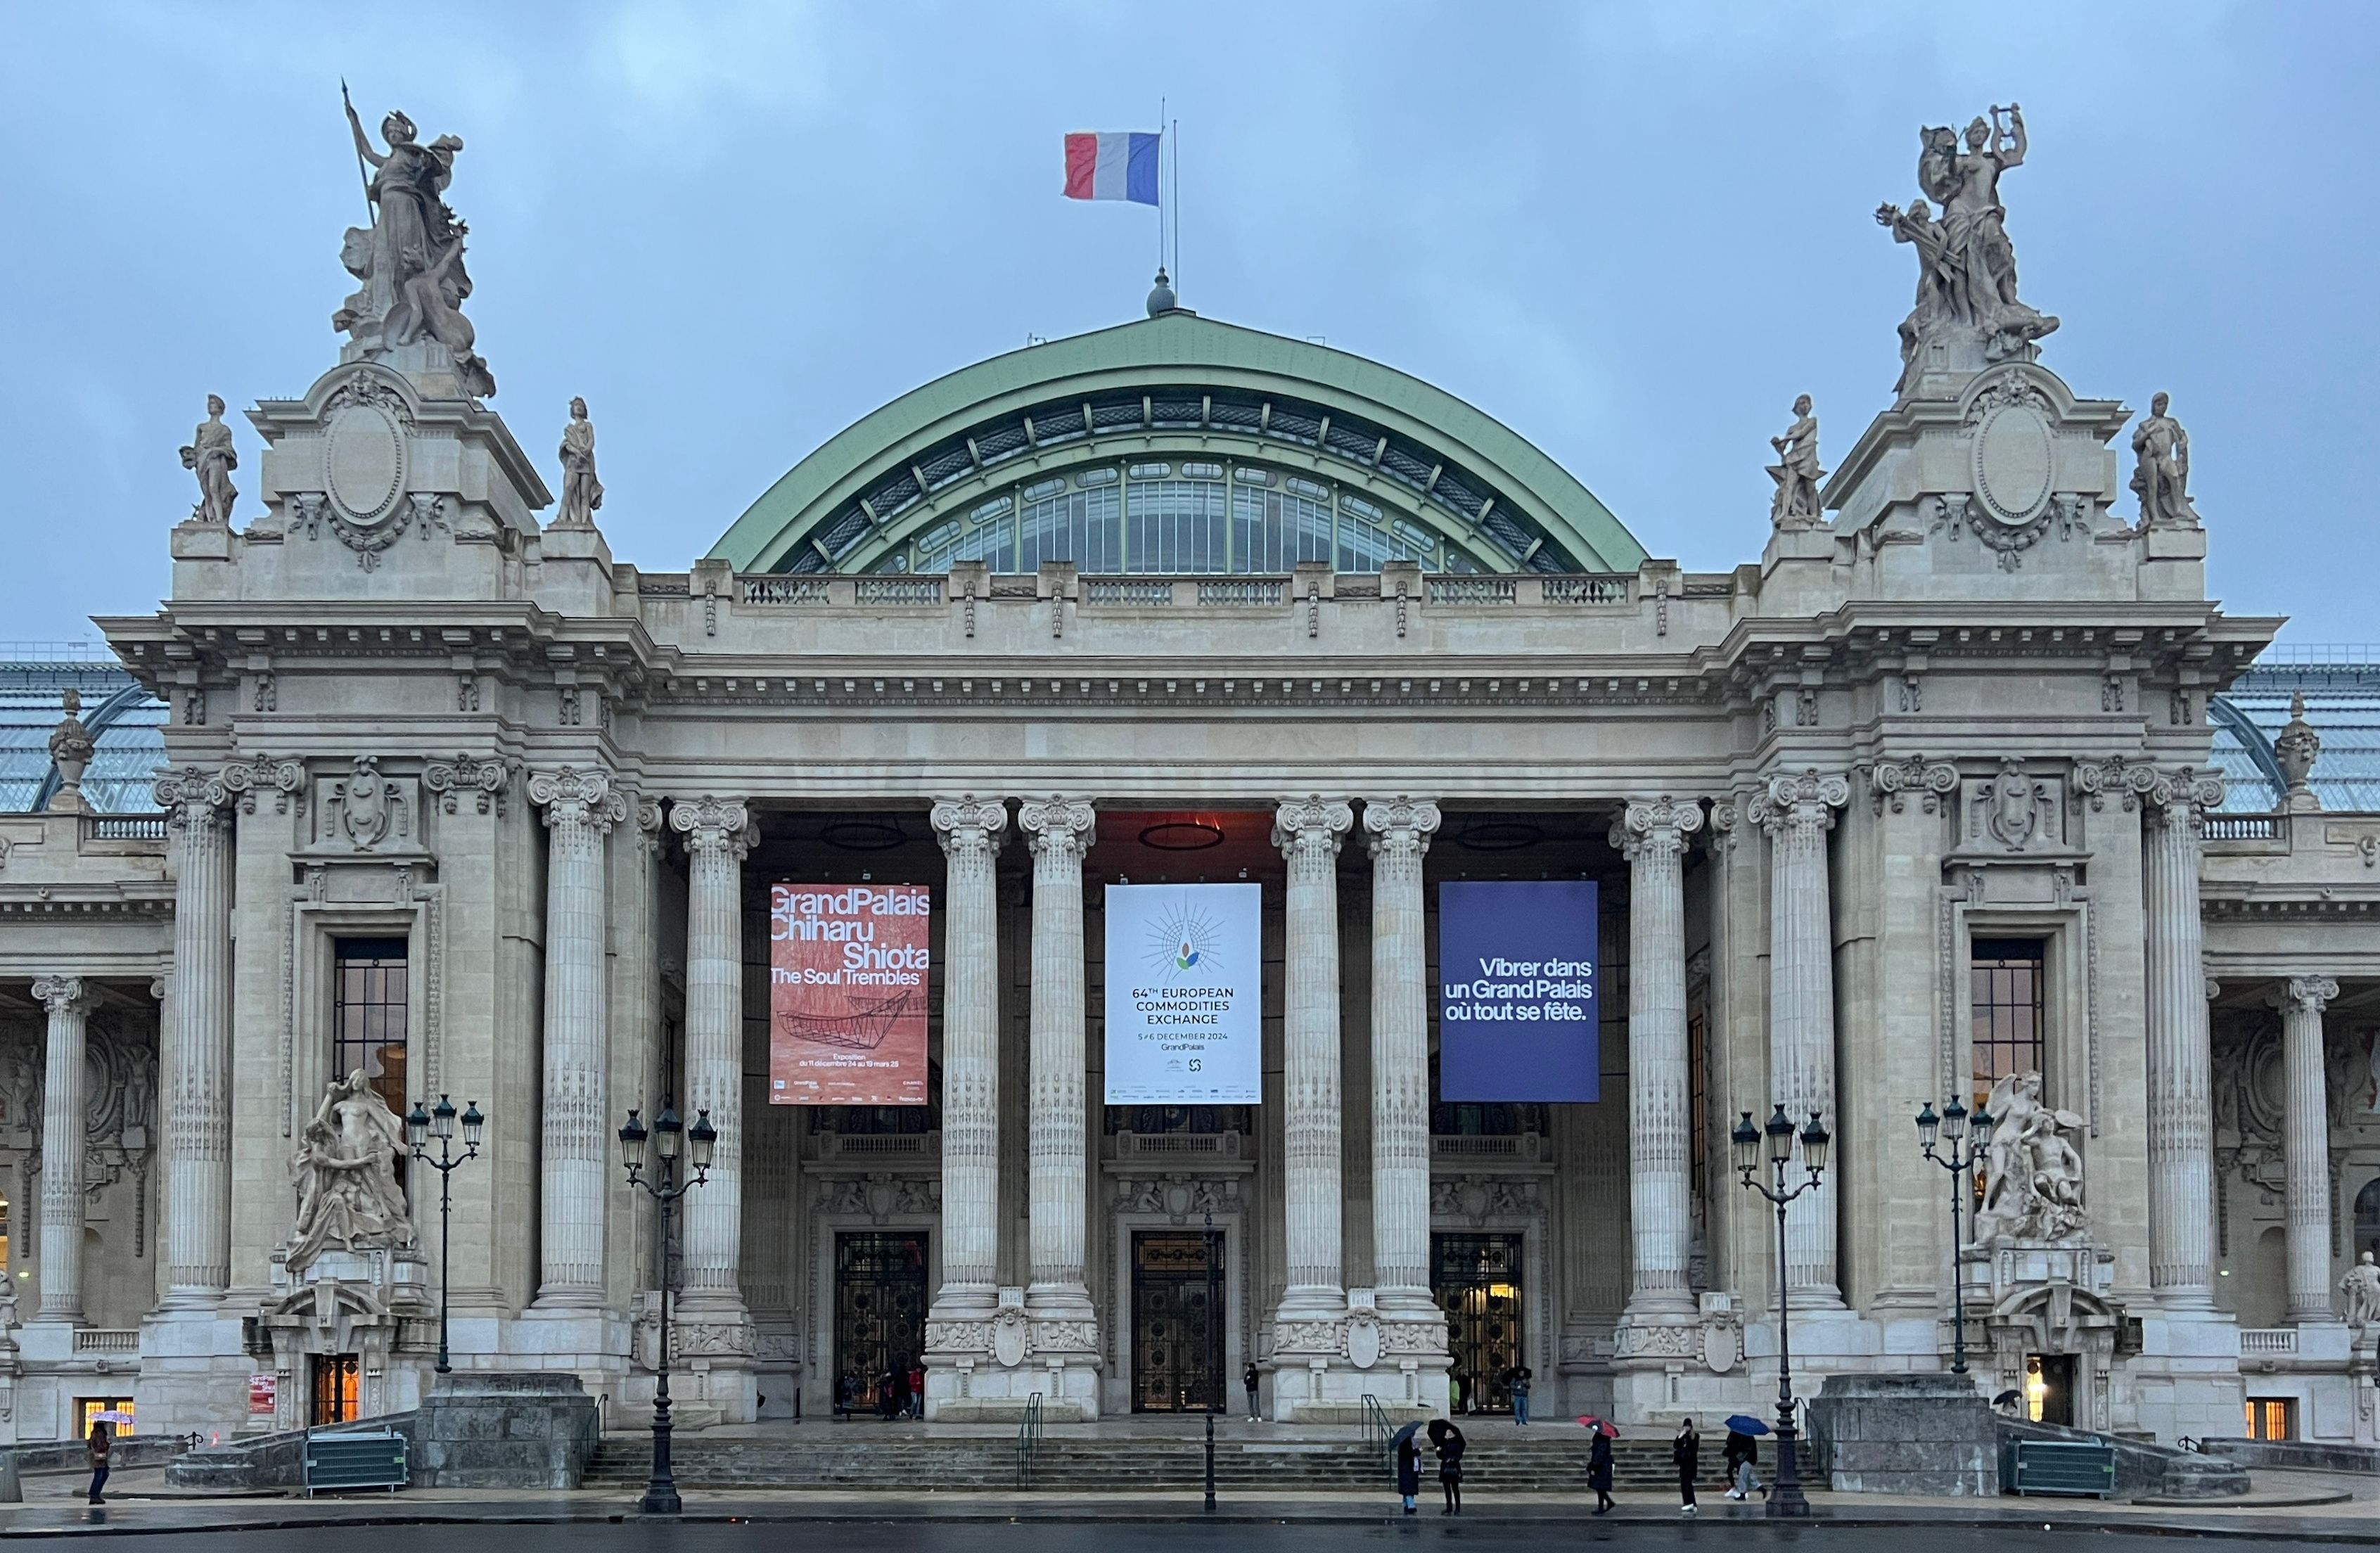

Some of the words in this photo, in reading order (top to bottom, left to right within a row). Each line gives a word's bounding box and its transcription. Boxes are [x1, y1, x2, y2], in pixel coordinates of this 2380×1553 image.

[771, 886, 929, 915] GrandPalais
[771, 914, 874, 942] Chiharu
[844, 942, 929, 969] Shiota
[772, 968, 802, 984] The
[804, 968, 840, 985] Soul
[843, 969, 920, 985] Trembles
[1479, 958, 1541, 977] Vibrer
[1544, 958, 1592, 977] dans
[1162, 988, 1234, 998] EUROPEAN
[1445, 984, 1470, 999] un
[1472, 980, 1534, 999] Grand
[1536, 980, 1593, 999] Palais
[1137, 1001, 1229, 1011] COMMODITIES
[1445, 1002, 1471, 1021] où
[1473, 1002, 1514, 1021] tout
[1516, 1006, 1541, 1021] se
[1543, 1002, 1587, 1021] fête.
[1147, 1014, 1218, 1024] EXCHANGE
